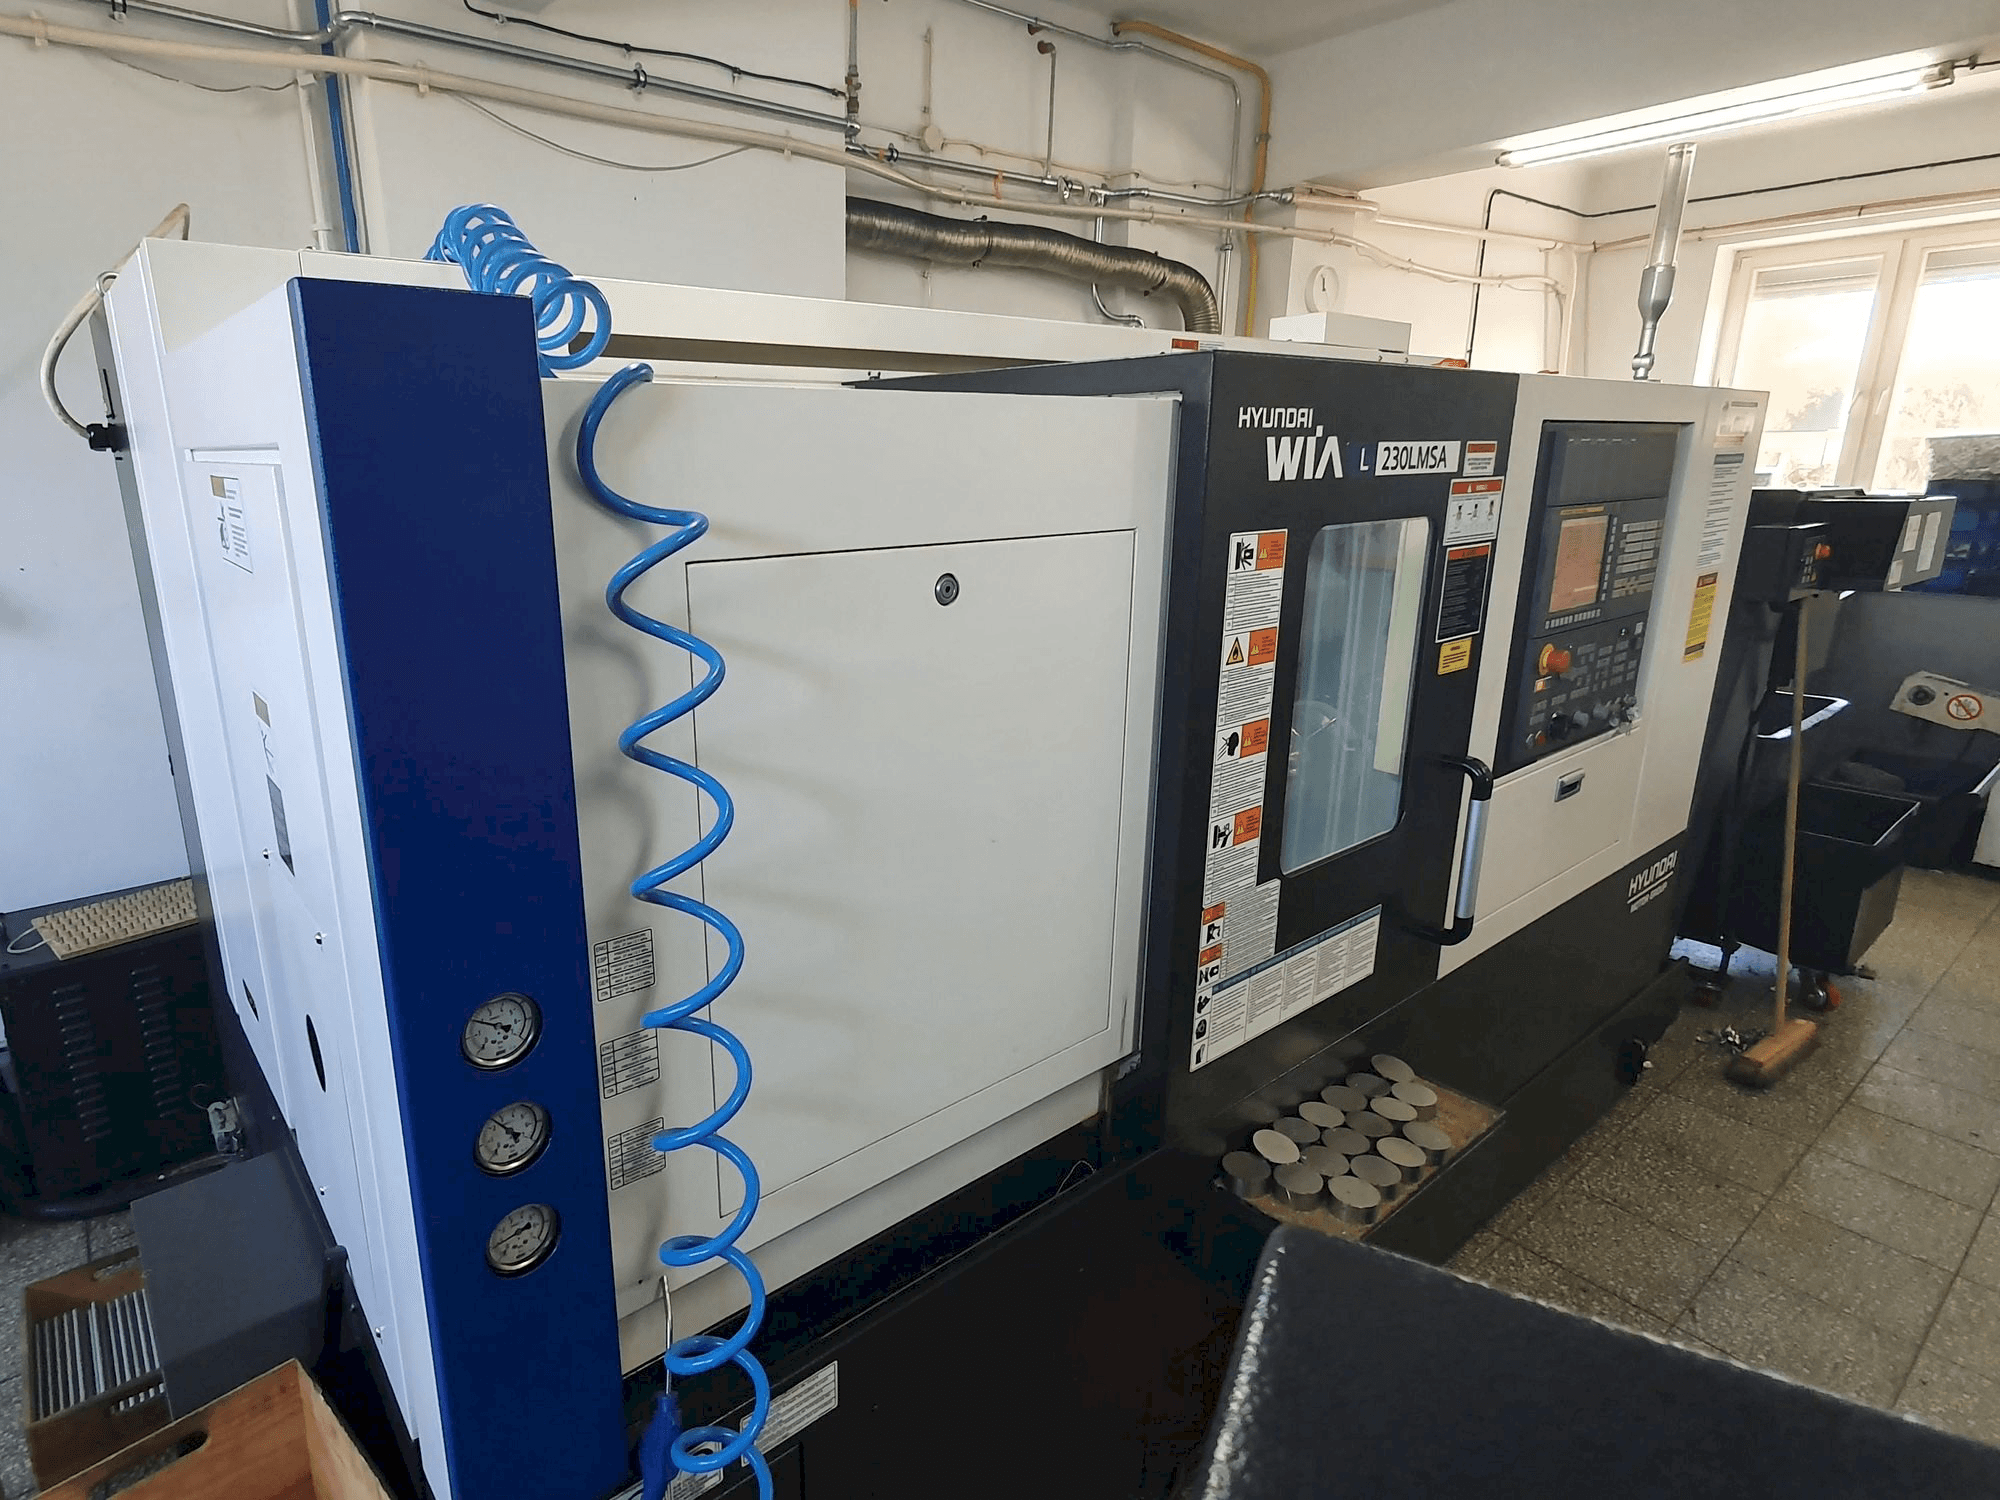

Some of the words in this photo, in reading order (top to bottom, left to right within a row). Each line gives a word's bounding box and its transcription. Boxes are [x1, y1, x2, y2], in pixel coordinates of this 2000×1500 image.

[1238, 407, 1314, 429] HYUNDAI
[1266, 424, 1344, 482] WIA
[1359, 446, 1370, 471] L
[1381, 445, 1447, 471] 230LMSA
[1628, 850, 1678, 898] HYUNDAI
